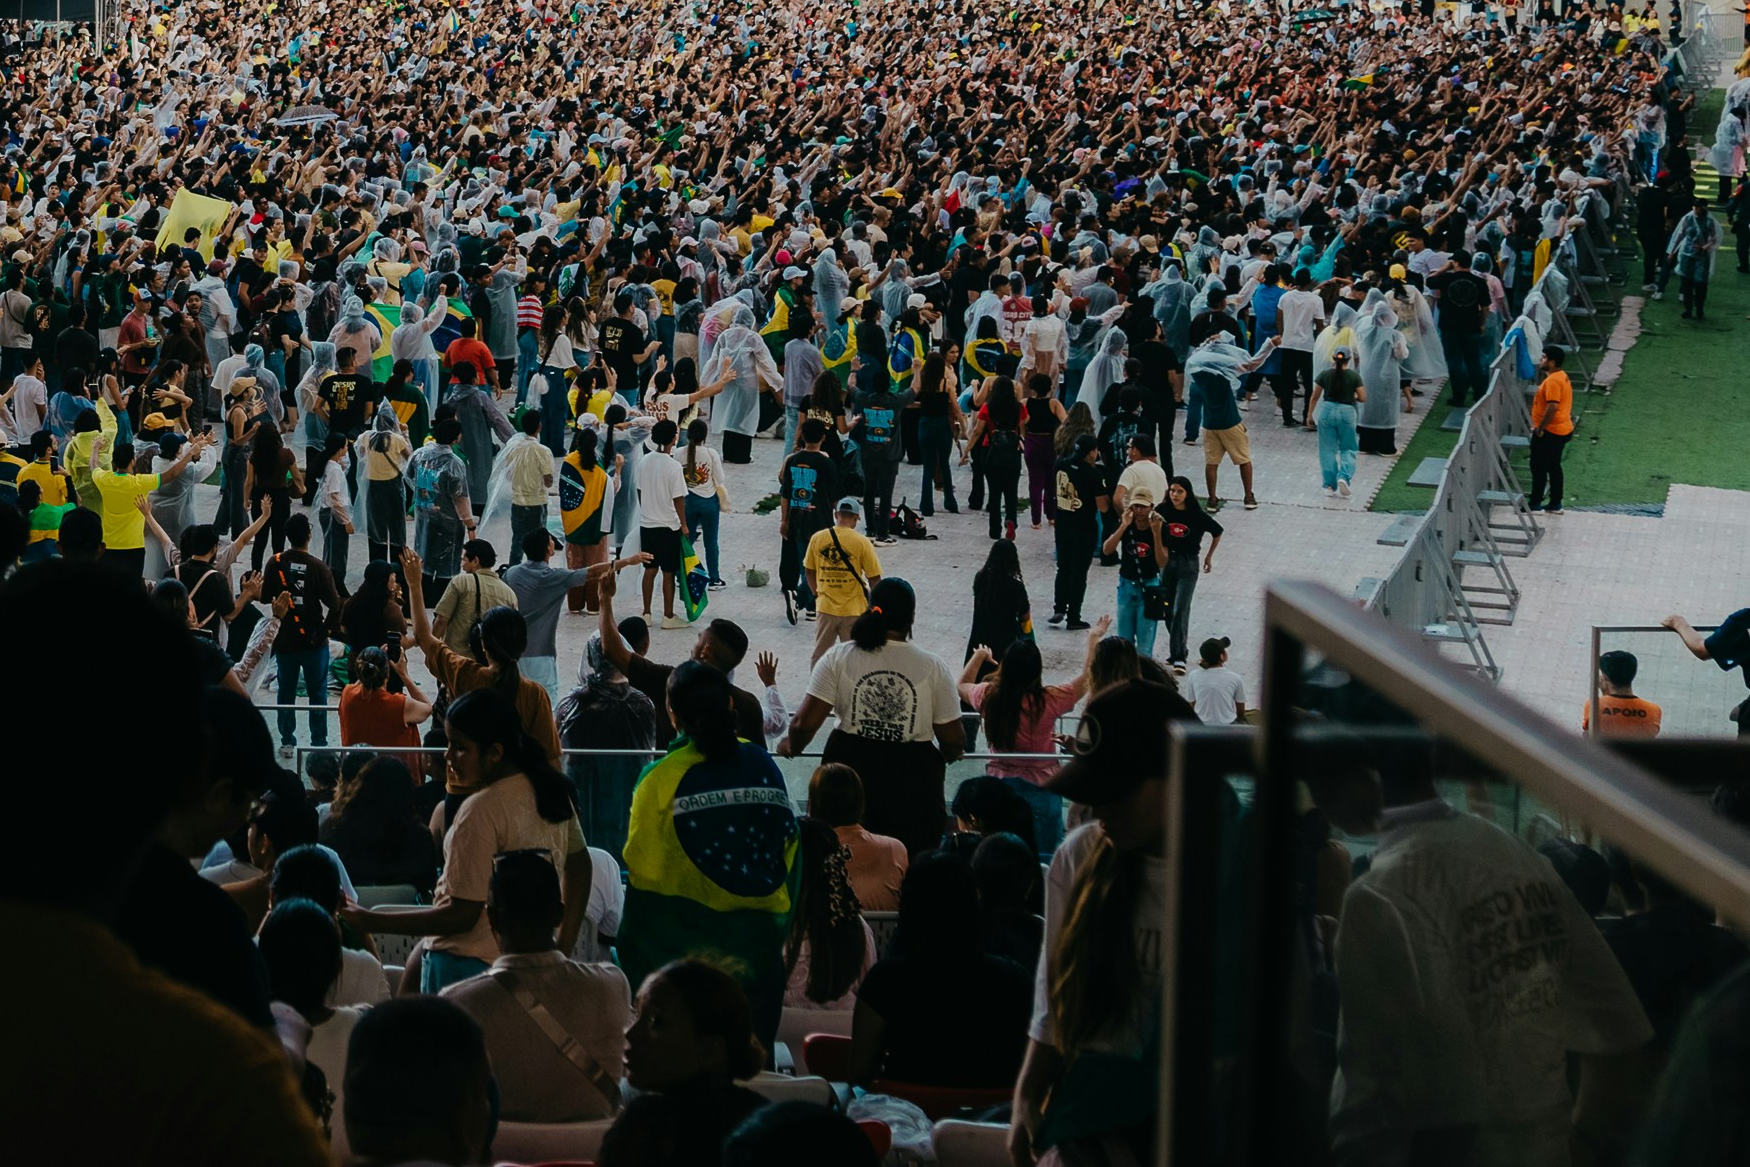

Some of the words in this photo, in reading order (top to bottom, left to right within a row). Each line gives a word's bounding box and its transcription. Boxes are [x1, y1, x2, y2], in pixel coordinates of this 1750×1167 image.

[1602, 707, 1647, 718] APOIO
[859, 719, 886, 728] THERE
[887, 722, 904, 731] WAS
[857, 726, 904, 741] JESUS
[679, 792, 727, 811] ORDEM
[733, 791, 742, 803] E
